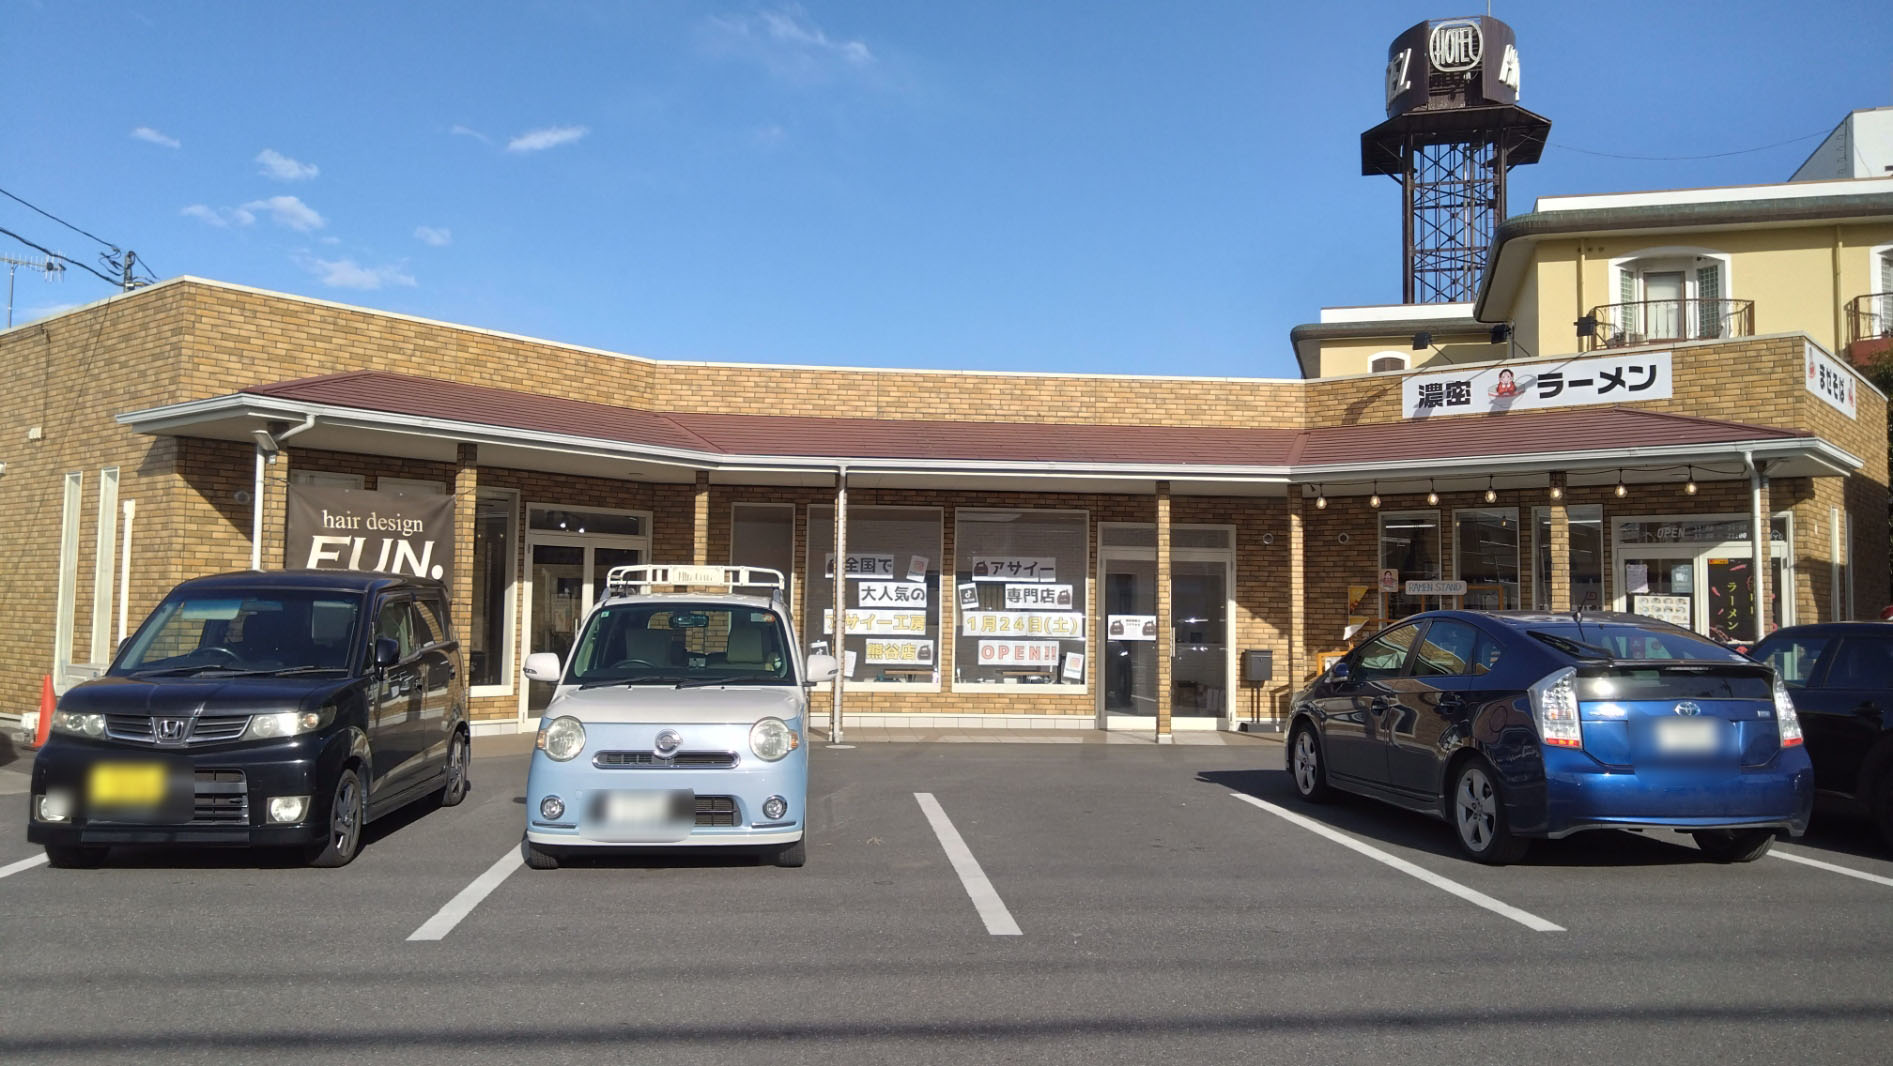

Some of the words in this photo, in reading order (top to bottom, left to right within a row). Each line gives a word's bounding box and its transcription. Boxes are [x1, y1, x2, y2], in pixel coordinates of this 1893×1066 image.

[1432, 27, 1479, 65] HOTEL
[1418, 380, 1472, 408] 濃密
[1537, 364, 1657, 399] ラーメン
[322, 509, 361, 529] hair
[366, 512, 424, 536] design
[1656, 527, 1687, 539] OPEN
[845, 557, 892, 573] 全国で
[990, 561, 1054, 576] アサイー
[861, 586, 925, 602] 大人気の
[1006, 588, 1055, 604] 専門店
[1727, 581, 1739, 631] ラーメン
[966, 615, 1078, 634] 1月24日(土)
[866, 643, 916, 660] 熊谷店
[981, 645, 1057, 660] OPEN!!
